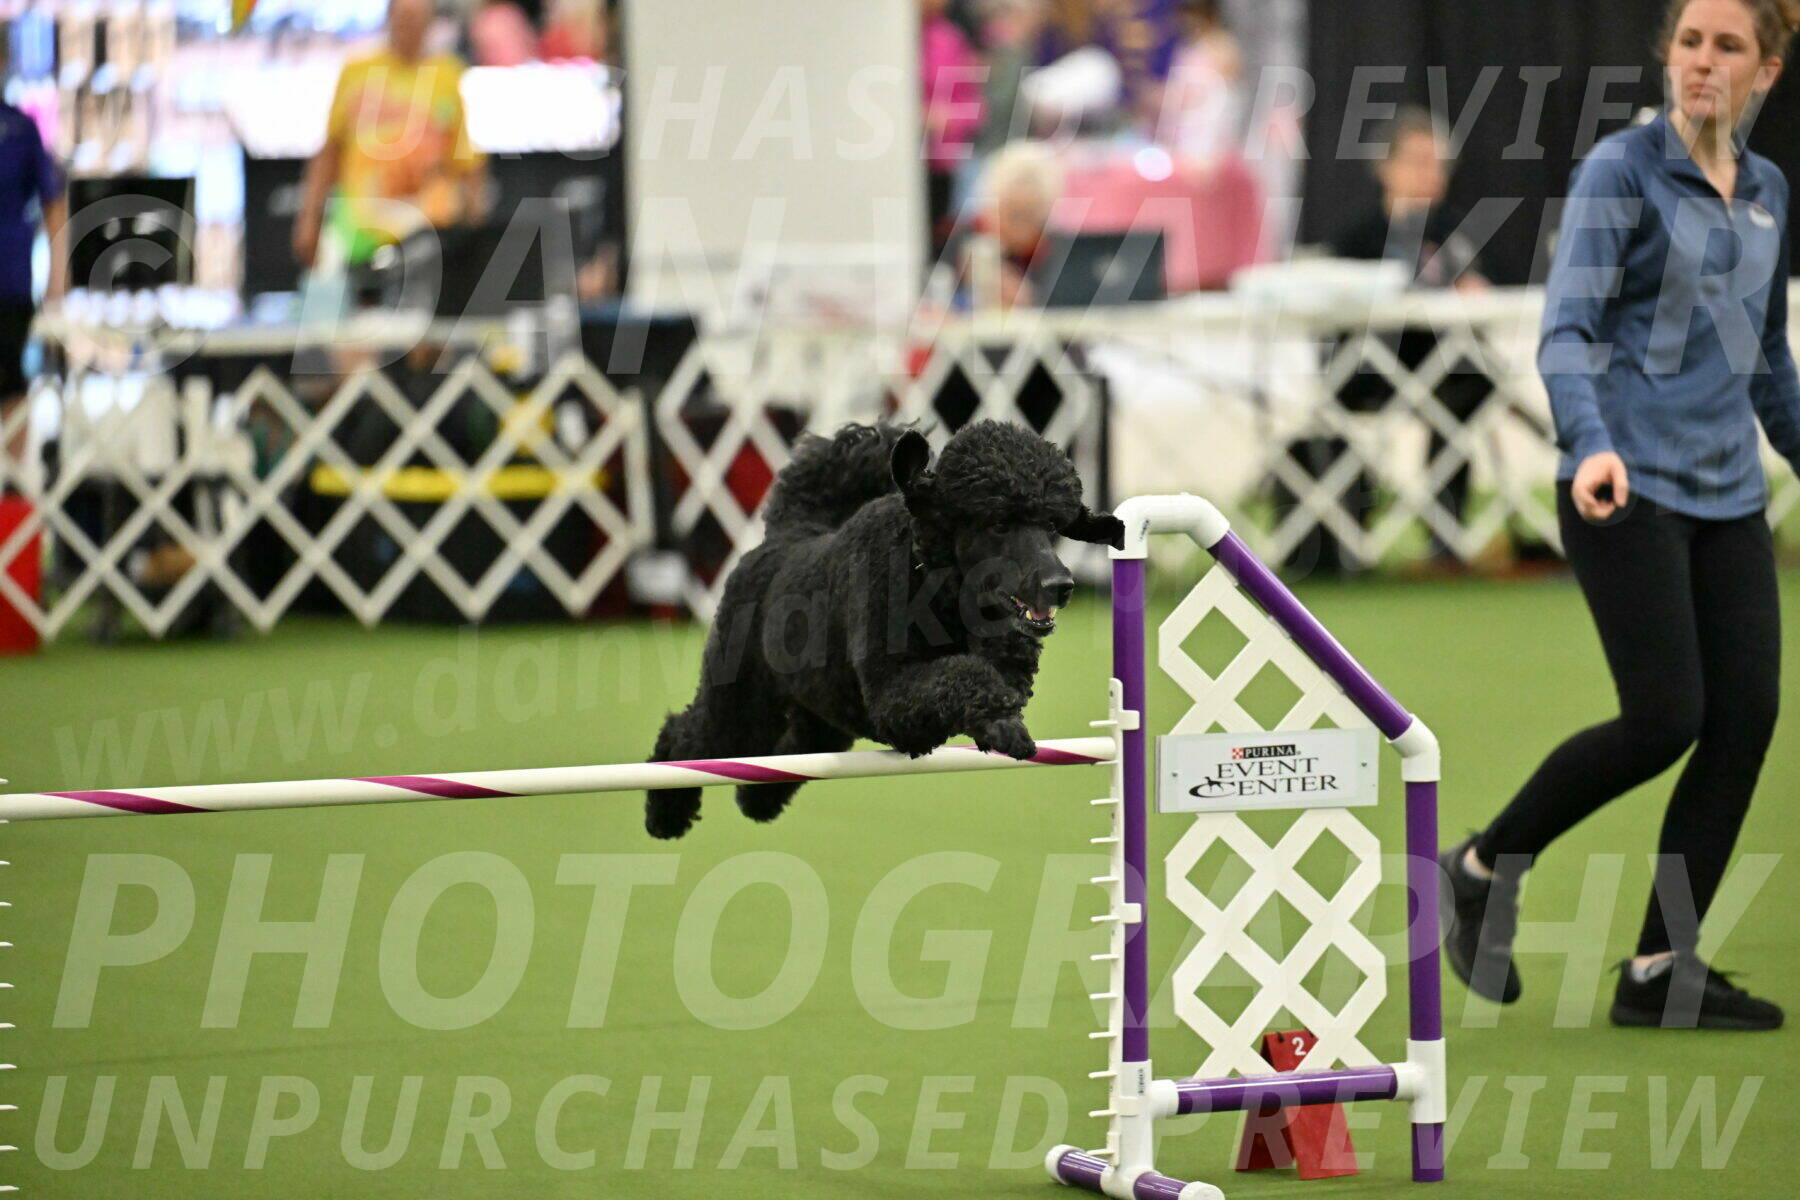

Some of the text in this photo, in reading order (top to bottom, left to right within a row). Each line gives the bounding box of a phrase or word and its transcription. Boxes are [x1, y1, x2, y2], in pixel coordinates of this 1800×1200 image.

[1245, 745, 1295, 758] PURINA
[1217, 757, 1319, 779] EVENT
[1189, 774, 1339, 798] CENTER
[1292, 1036, 1307, 1056] 2
